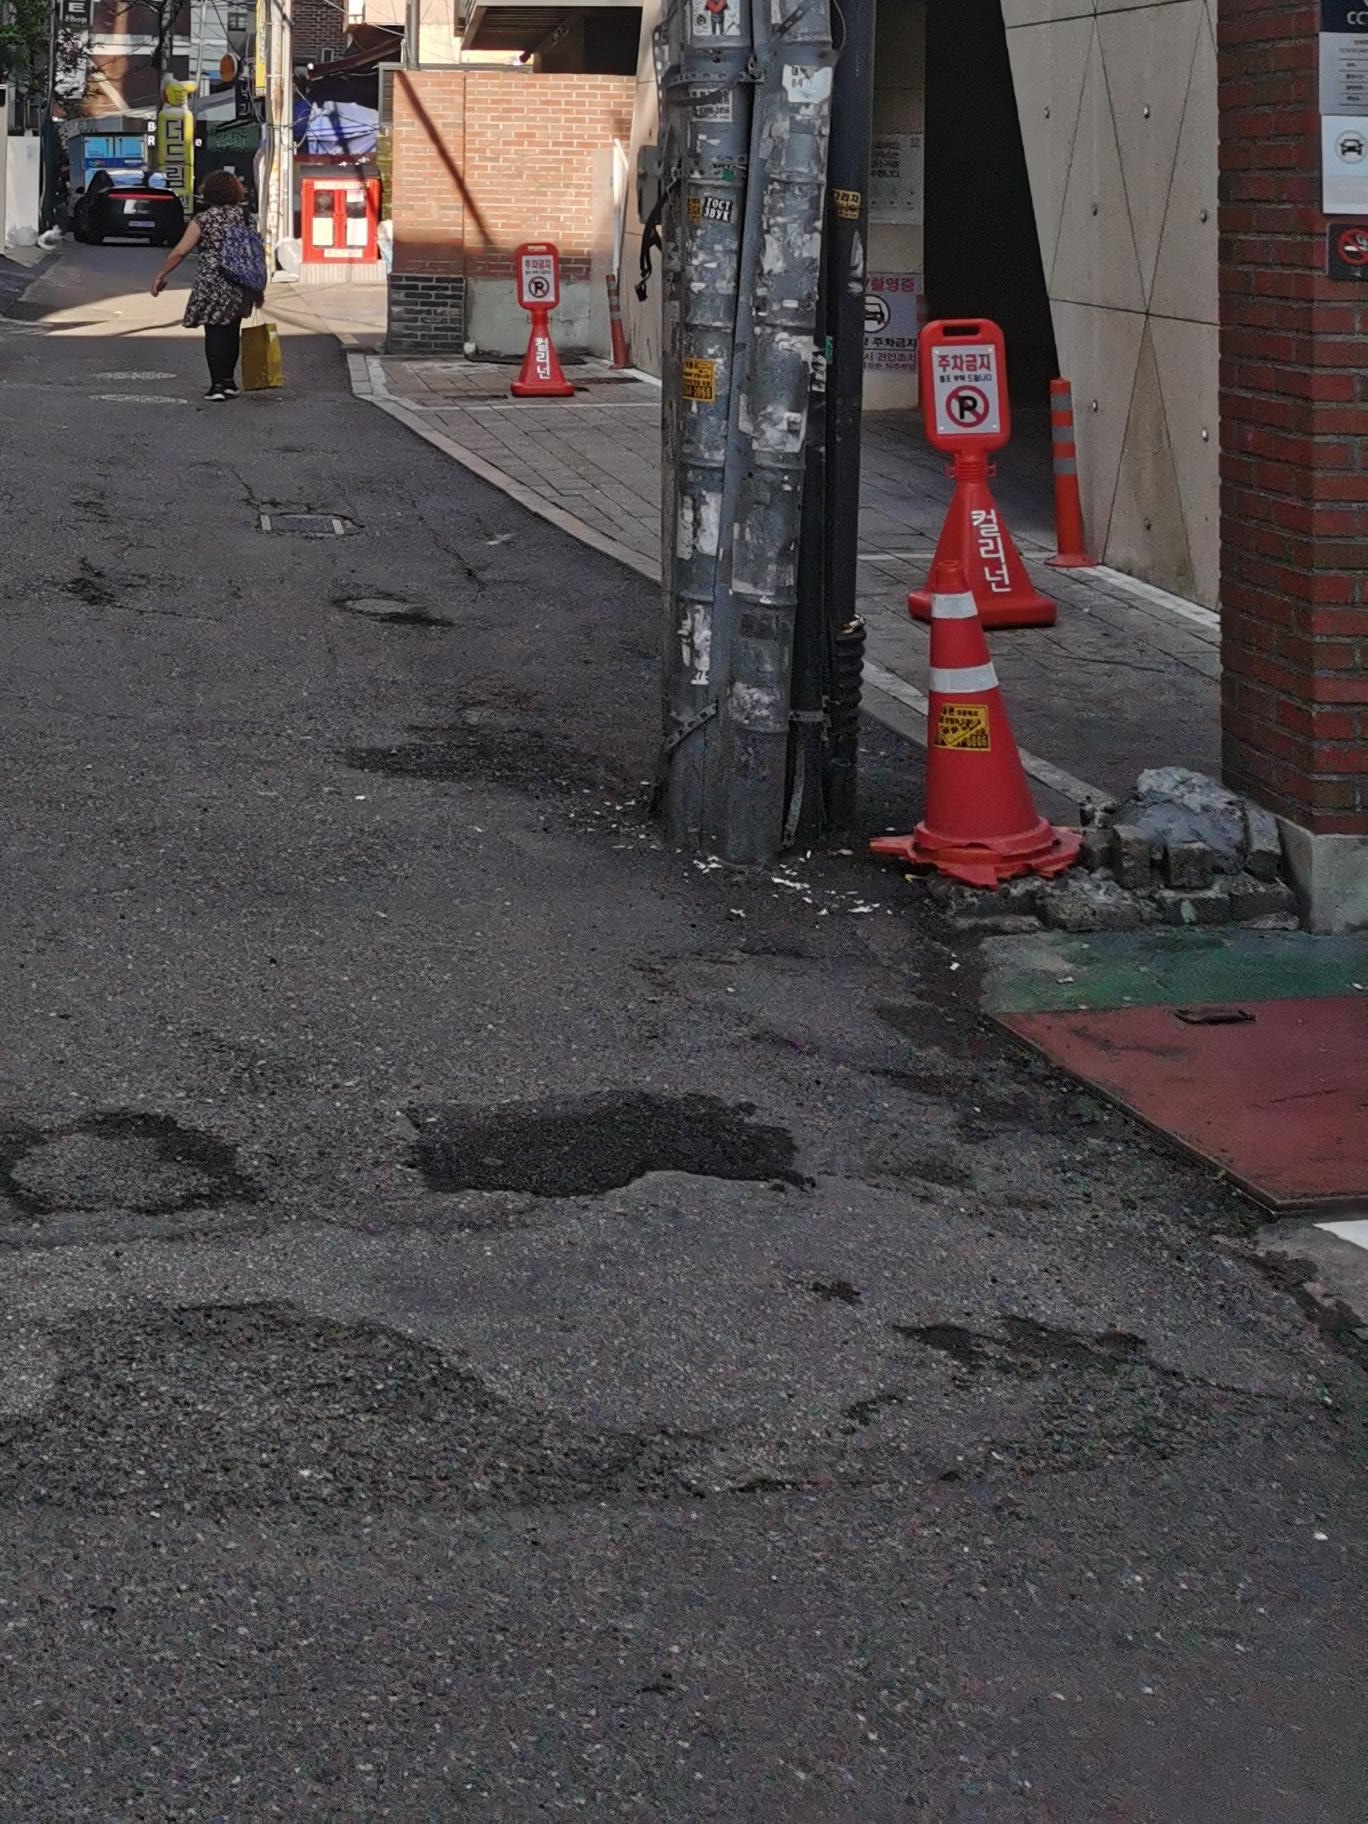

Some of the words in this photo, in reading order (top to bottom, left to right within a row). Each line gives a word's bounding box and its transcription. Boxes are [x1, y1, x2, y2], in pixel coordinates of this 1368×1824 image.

[938, 354, 991, 373] 주차금지
[958, 395, 978, 420] P
[971, 507, 1012, 593] 컬리넌
